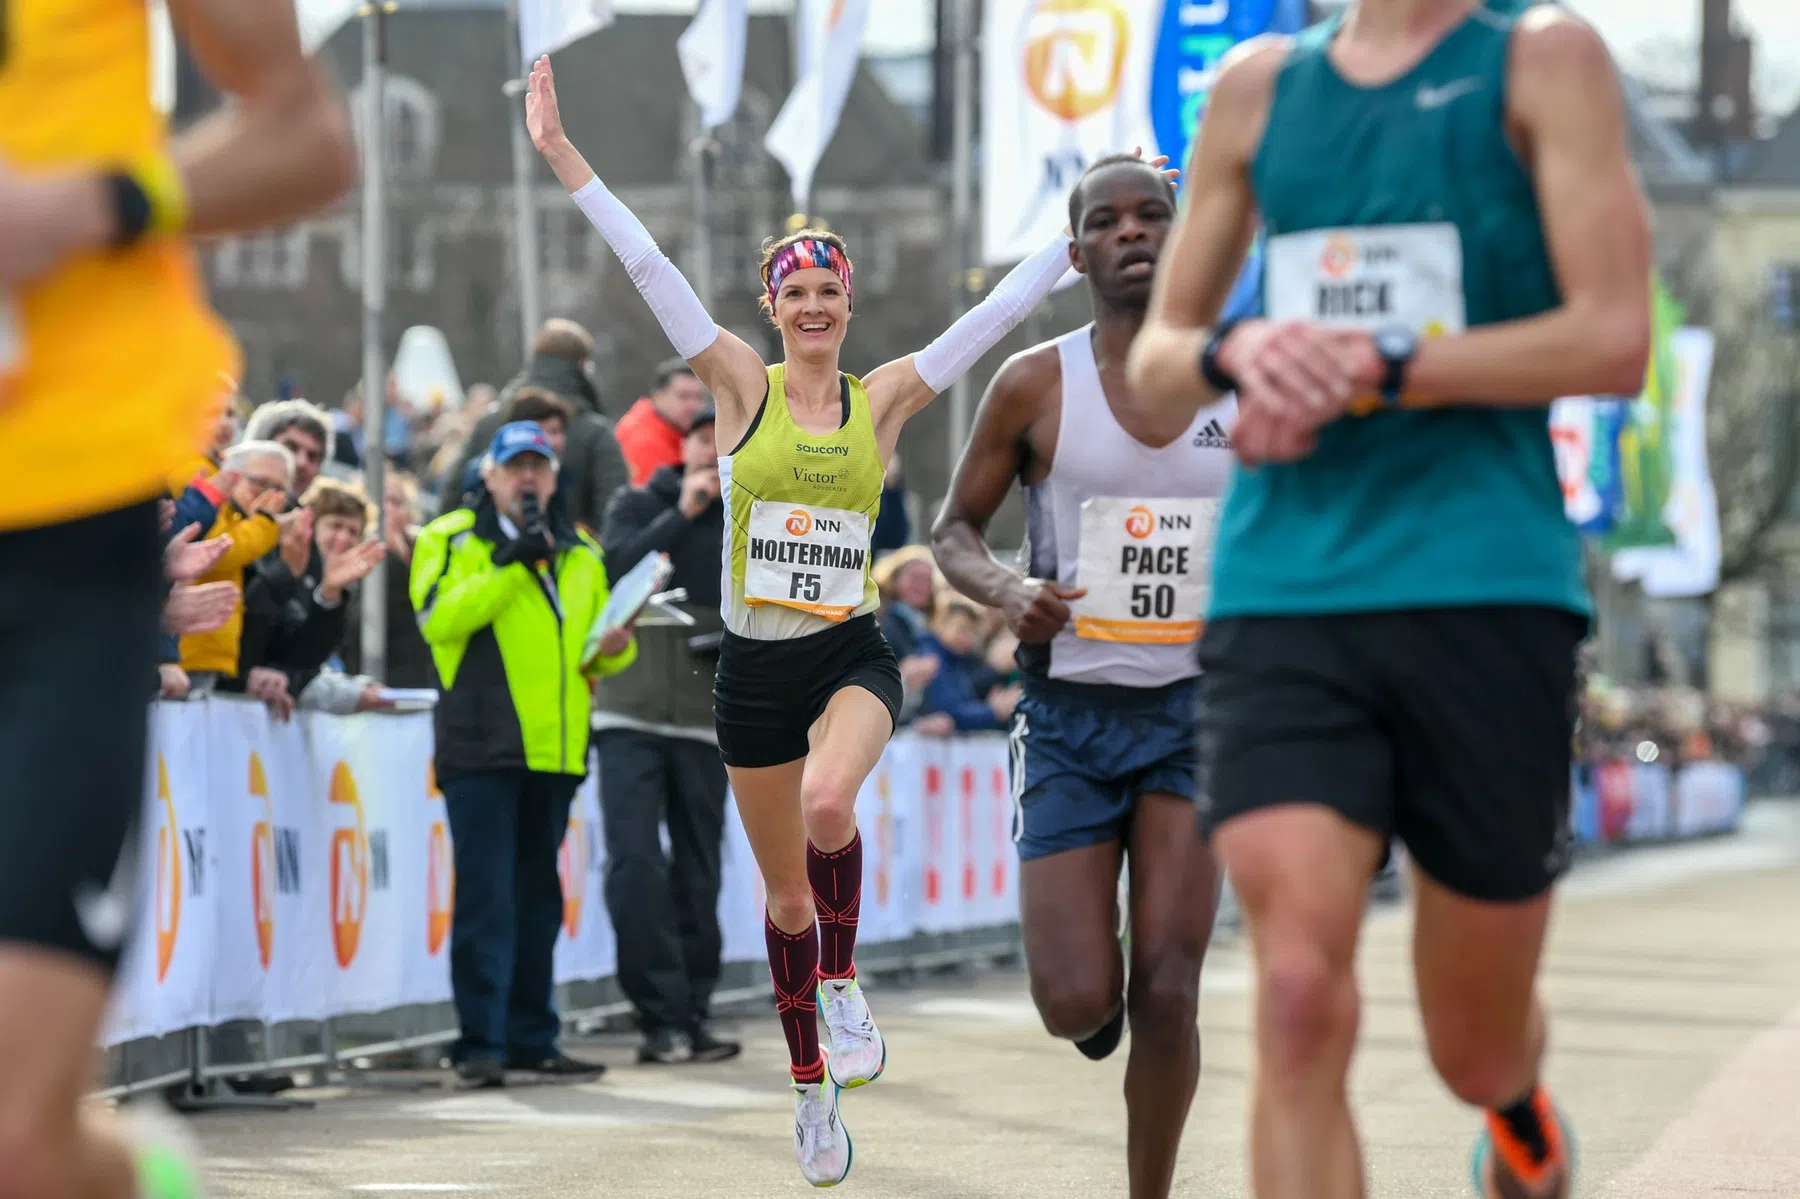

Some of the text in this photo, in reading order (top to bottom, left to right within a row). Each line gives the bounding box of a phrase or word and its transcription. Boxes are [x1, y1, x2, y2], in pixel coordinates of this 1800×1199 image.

[795, 443, 849, 456] saucony
[793, 467, 837, 484] Victor
[815, 518, 841, 533] NN
[1159, 515, 1191, 530] NN
[751, 538, 865, 571] HOLTERMAN
[1120, 546, 1189, 575] PACE
[789, 572, 822, 602] F5
[1130, 584, 1175, 619] 50
